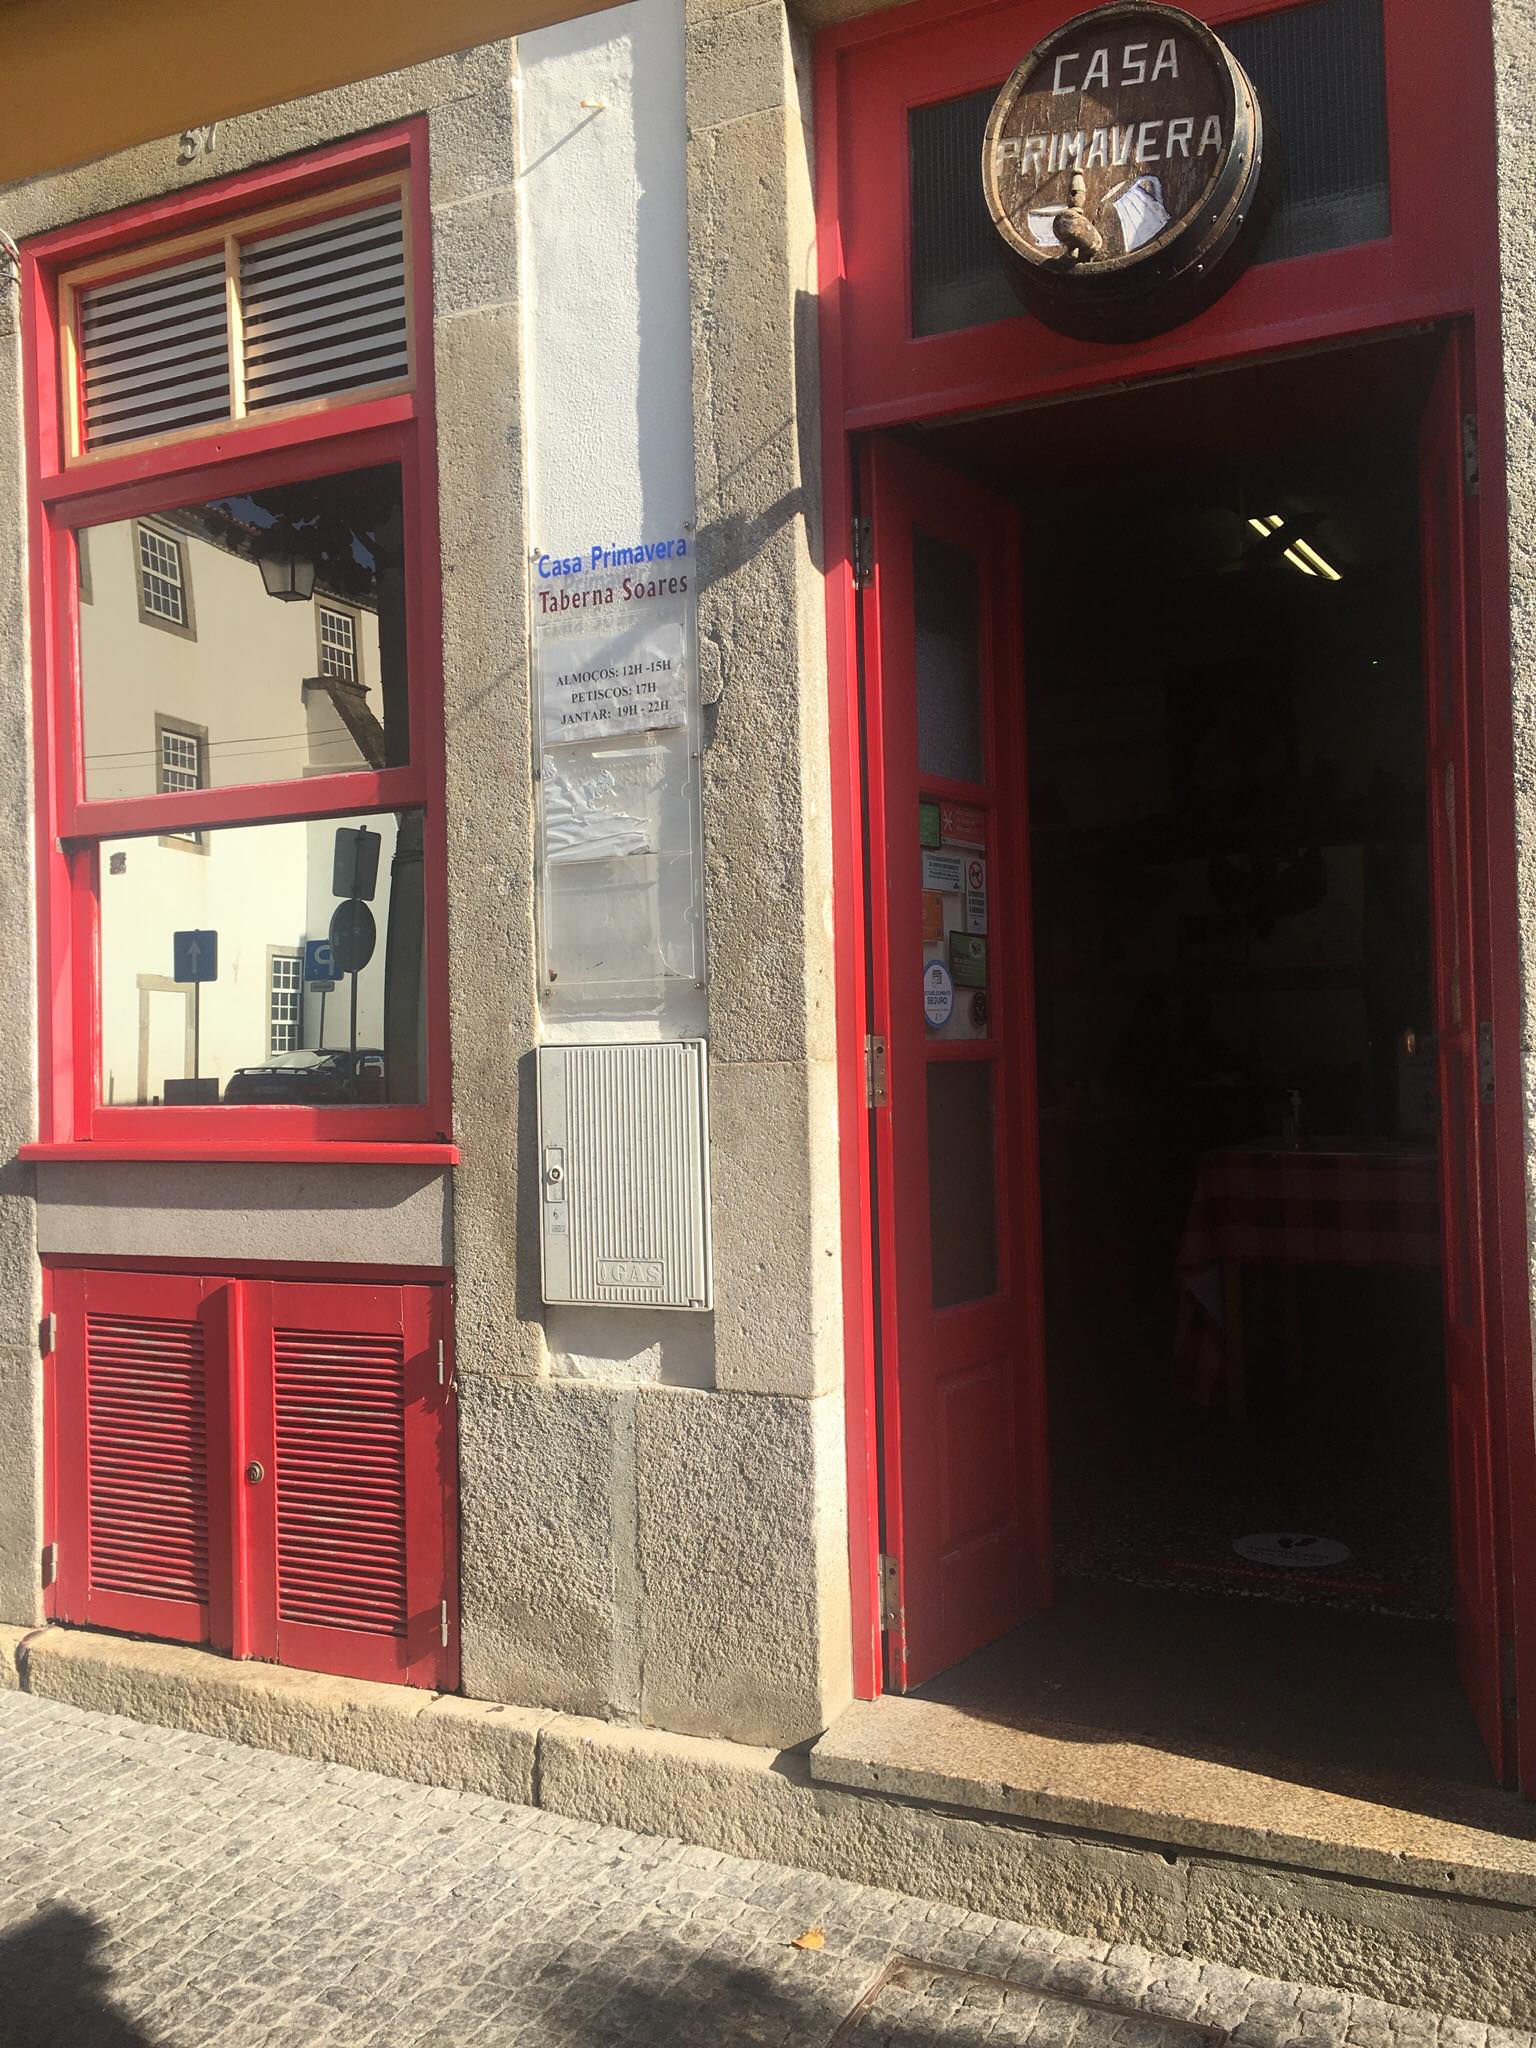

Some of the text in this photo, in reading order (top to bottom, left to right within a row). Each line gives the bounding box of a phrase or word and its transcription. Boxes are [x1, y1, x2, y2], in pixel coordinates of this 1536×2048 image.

[1052, 37, 1180, 97] CASA
[995, 114, 1225, 179] PRIMAVERA
[538, 538, 687, 579] Casa Primavera
[539, 575, 688, 614] Taberna Soares
[556, 667, 620, 687] ALMOÇOS:
[622, 662, 643, 677] 12H
[571, 682, 657, 704] PETISCOS: 17H
[560, 708, 612, 725] JANTAR:
[617, 703, 638, 717] 19H
[648, 700, 670, 714] 22H
